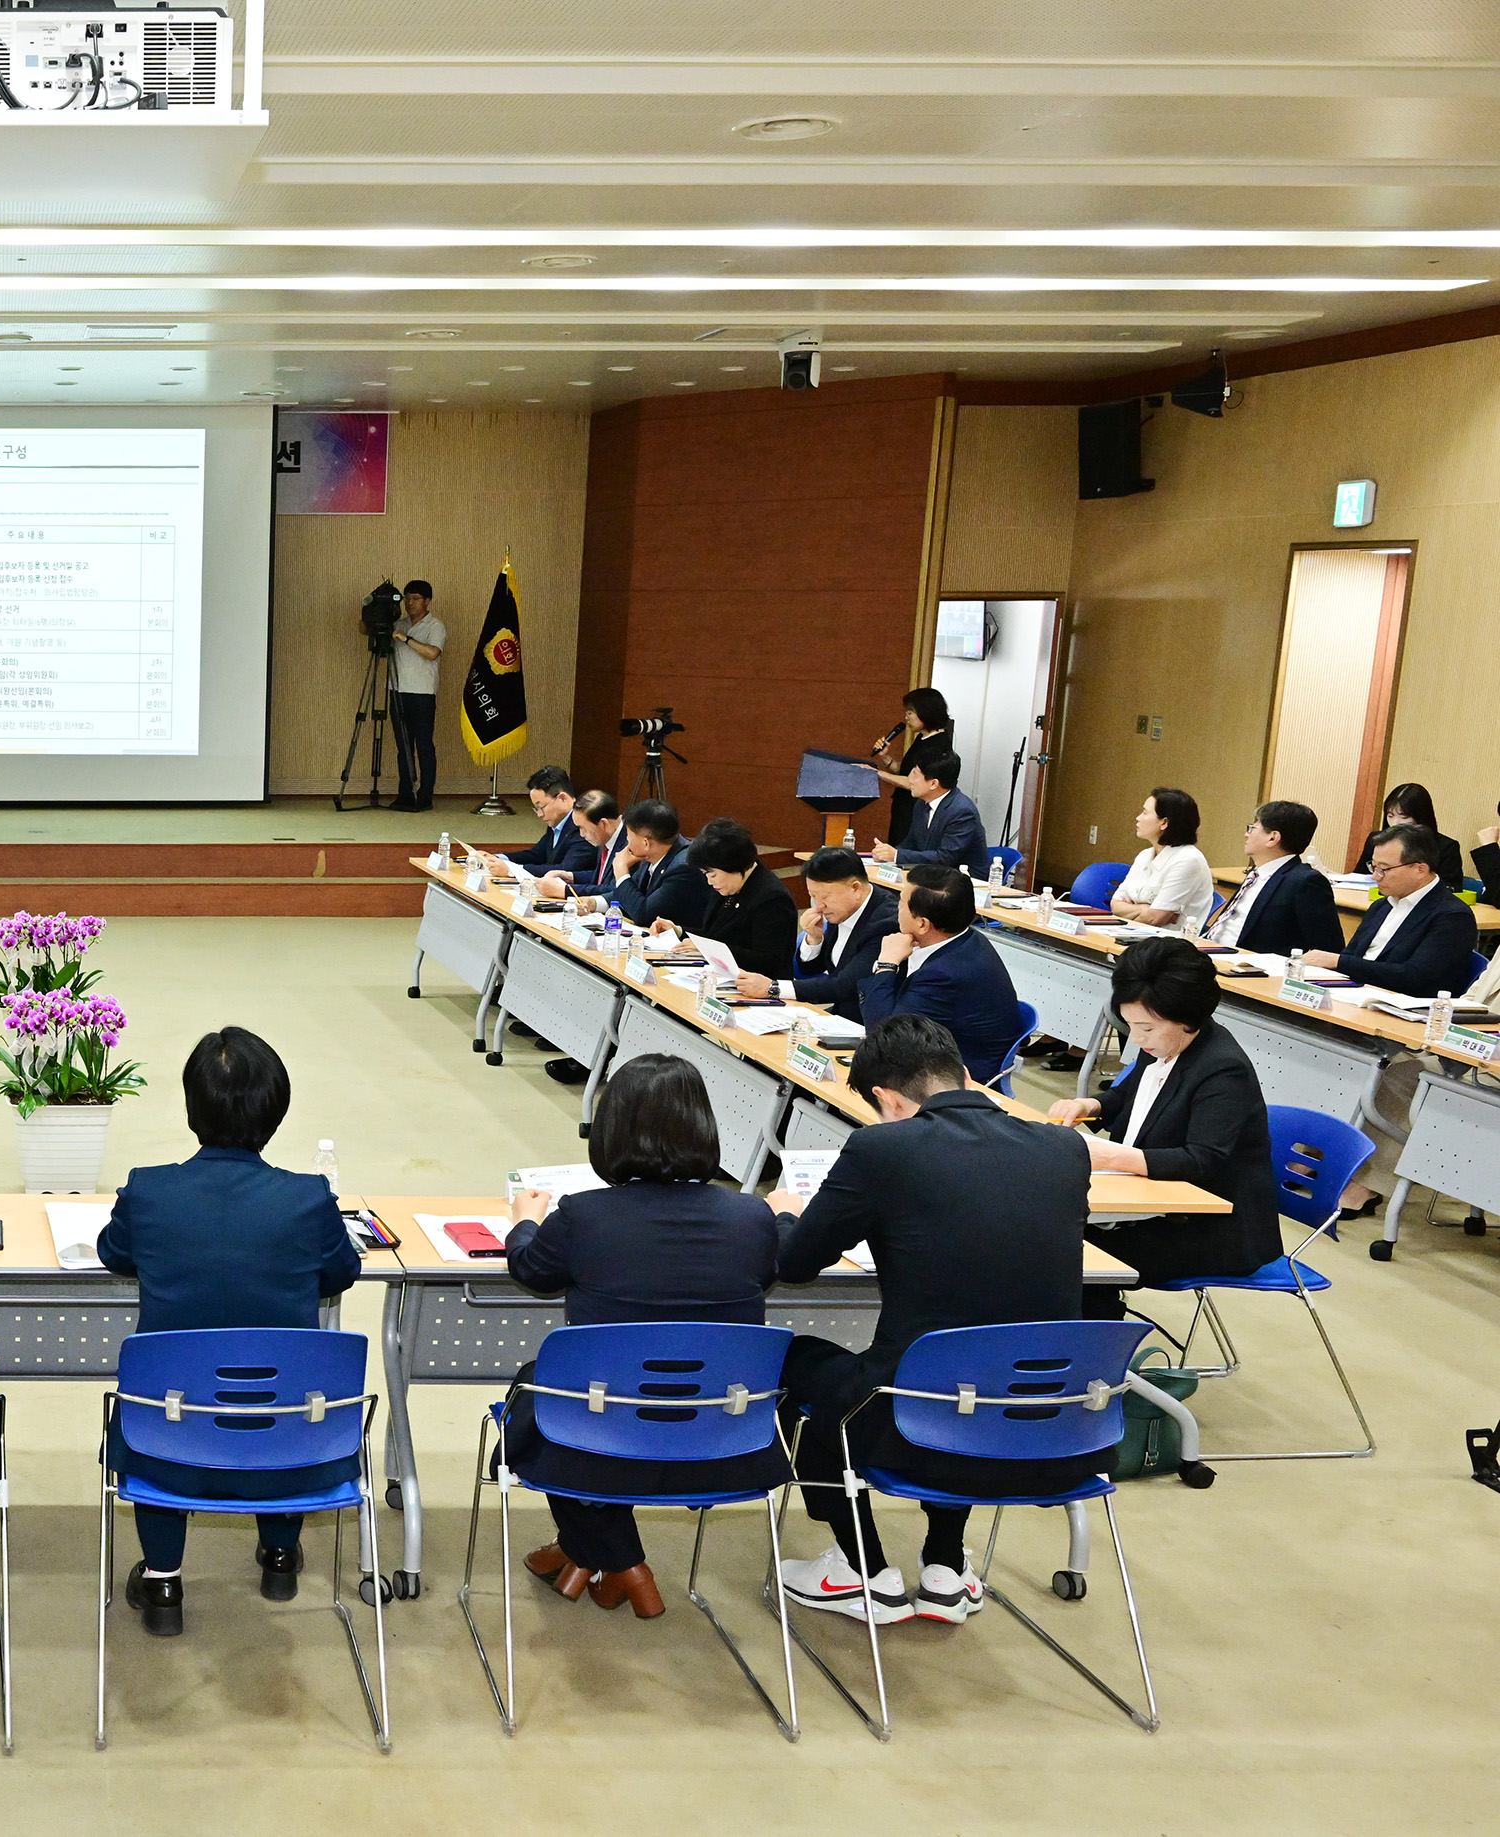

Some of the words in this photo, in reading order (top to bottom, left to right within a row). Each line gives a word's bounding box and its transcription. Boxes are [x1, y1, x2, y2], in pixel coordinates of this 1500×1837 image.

[277, 441, 301, 473] 션
[43, 562, 50, 570] 및
[52, 562, 72, 570] 선거일
[75, 562, 89, 570] 공고
[59, 575, 73, 584] 접수
[5, 605, 20, 614] 선거
[498, 641, 516, 664] 의회
[18, 671, 58, 679] 상임위원회)
[146, 672, 167, 680] 본회의
[22, 700, 54, 708] 예결특위)
[146, 701, 166, 709] 본회의
